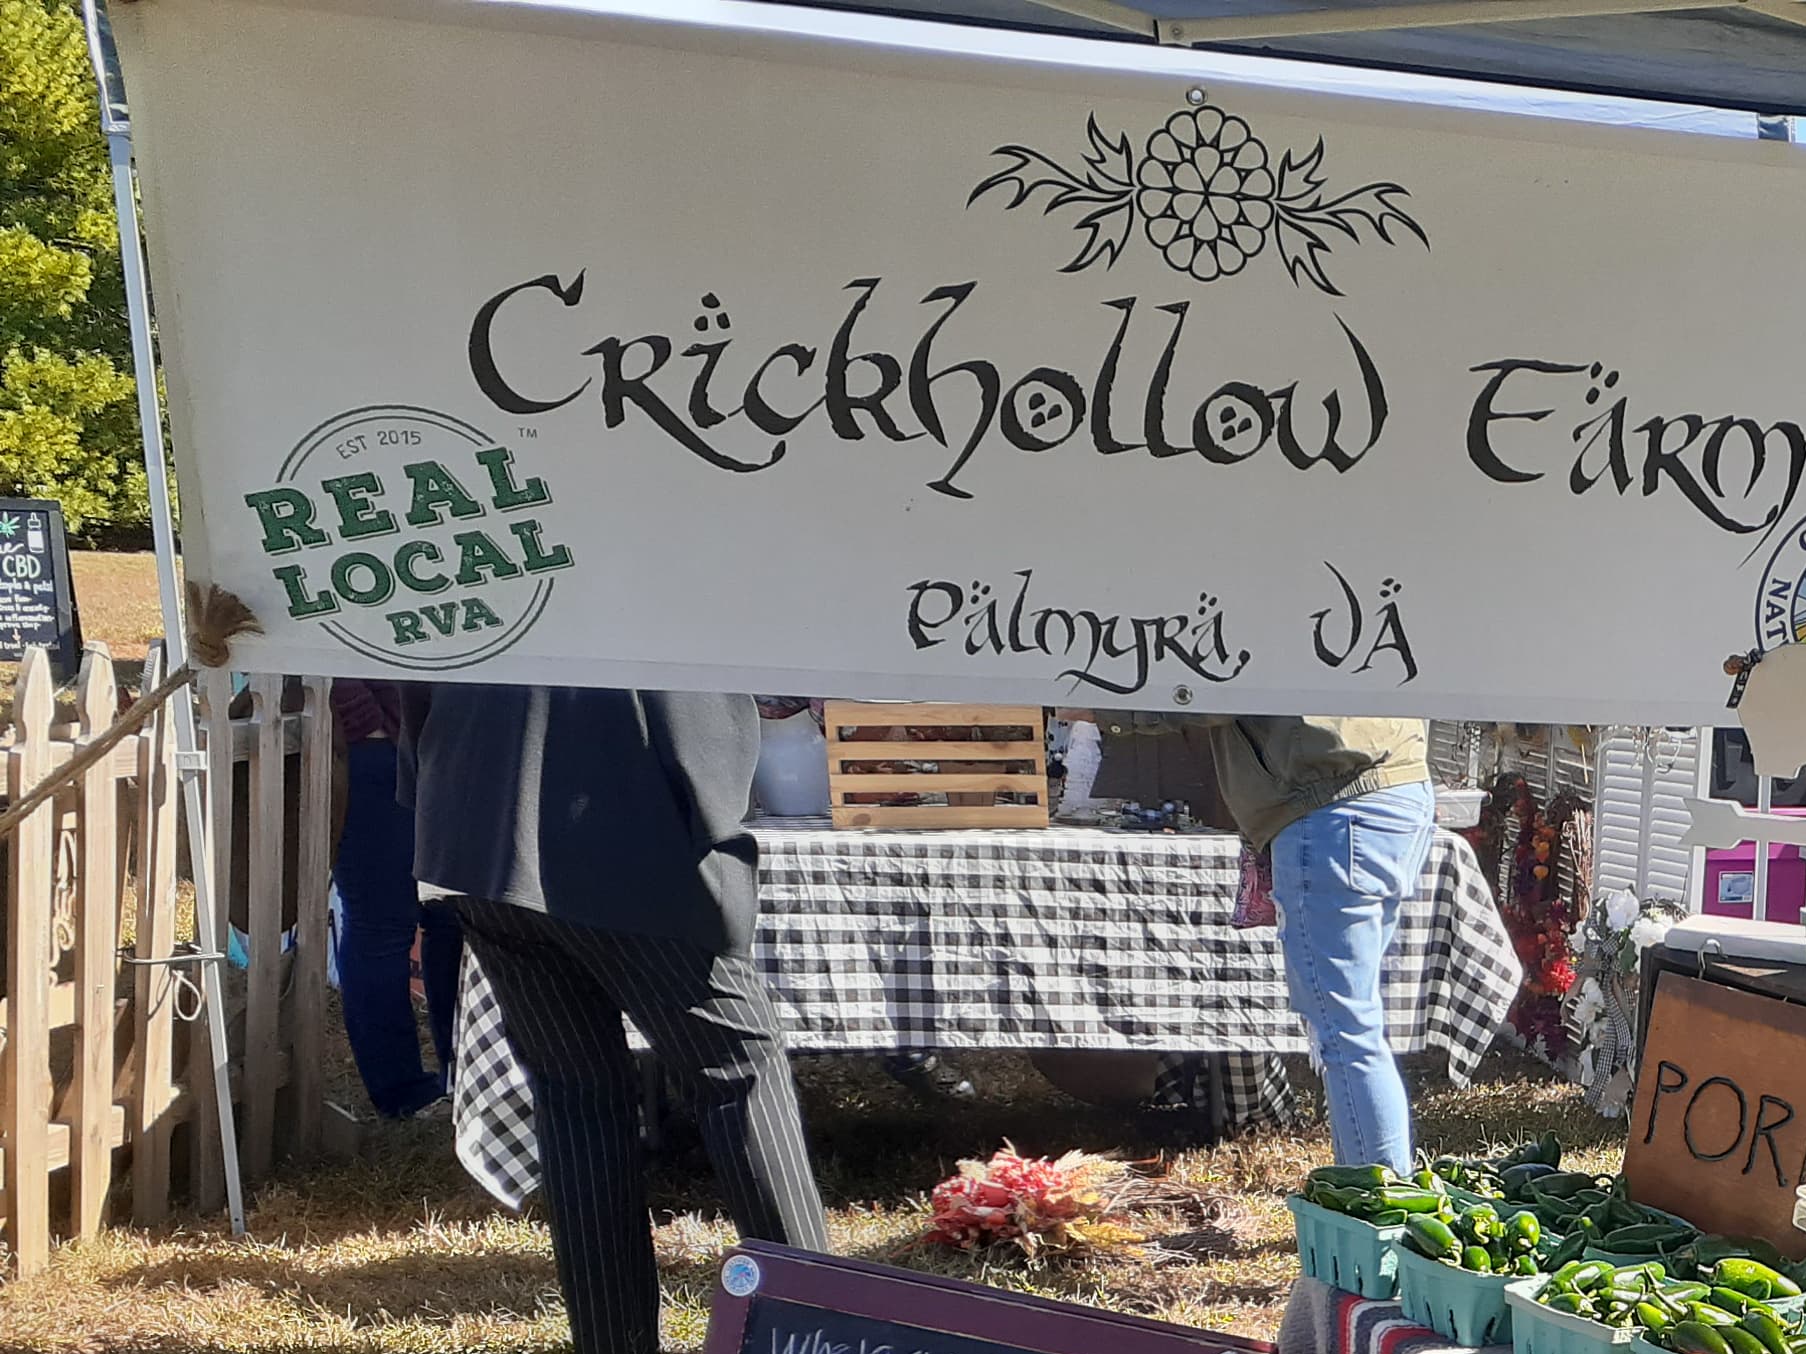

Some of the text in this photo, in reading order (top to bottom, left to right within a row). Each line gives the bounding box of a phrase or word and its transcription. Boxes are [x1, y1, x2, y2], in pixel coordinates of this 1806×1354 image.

[467, 267, 1390, 500] Crickhollow
[335, 429, 422, 459] EST 2015
[518, 427, 538, 439] TM
[244, 446, 552, 555] REAL
[2, 555, 41, 578] CBD
[272, 519, 575, 620] LOCAL
[385, 597, 504, 647] RVA
[1310, 560, 1418, 686] VA
